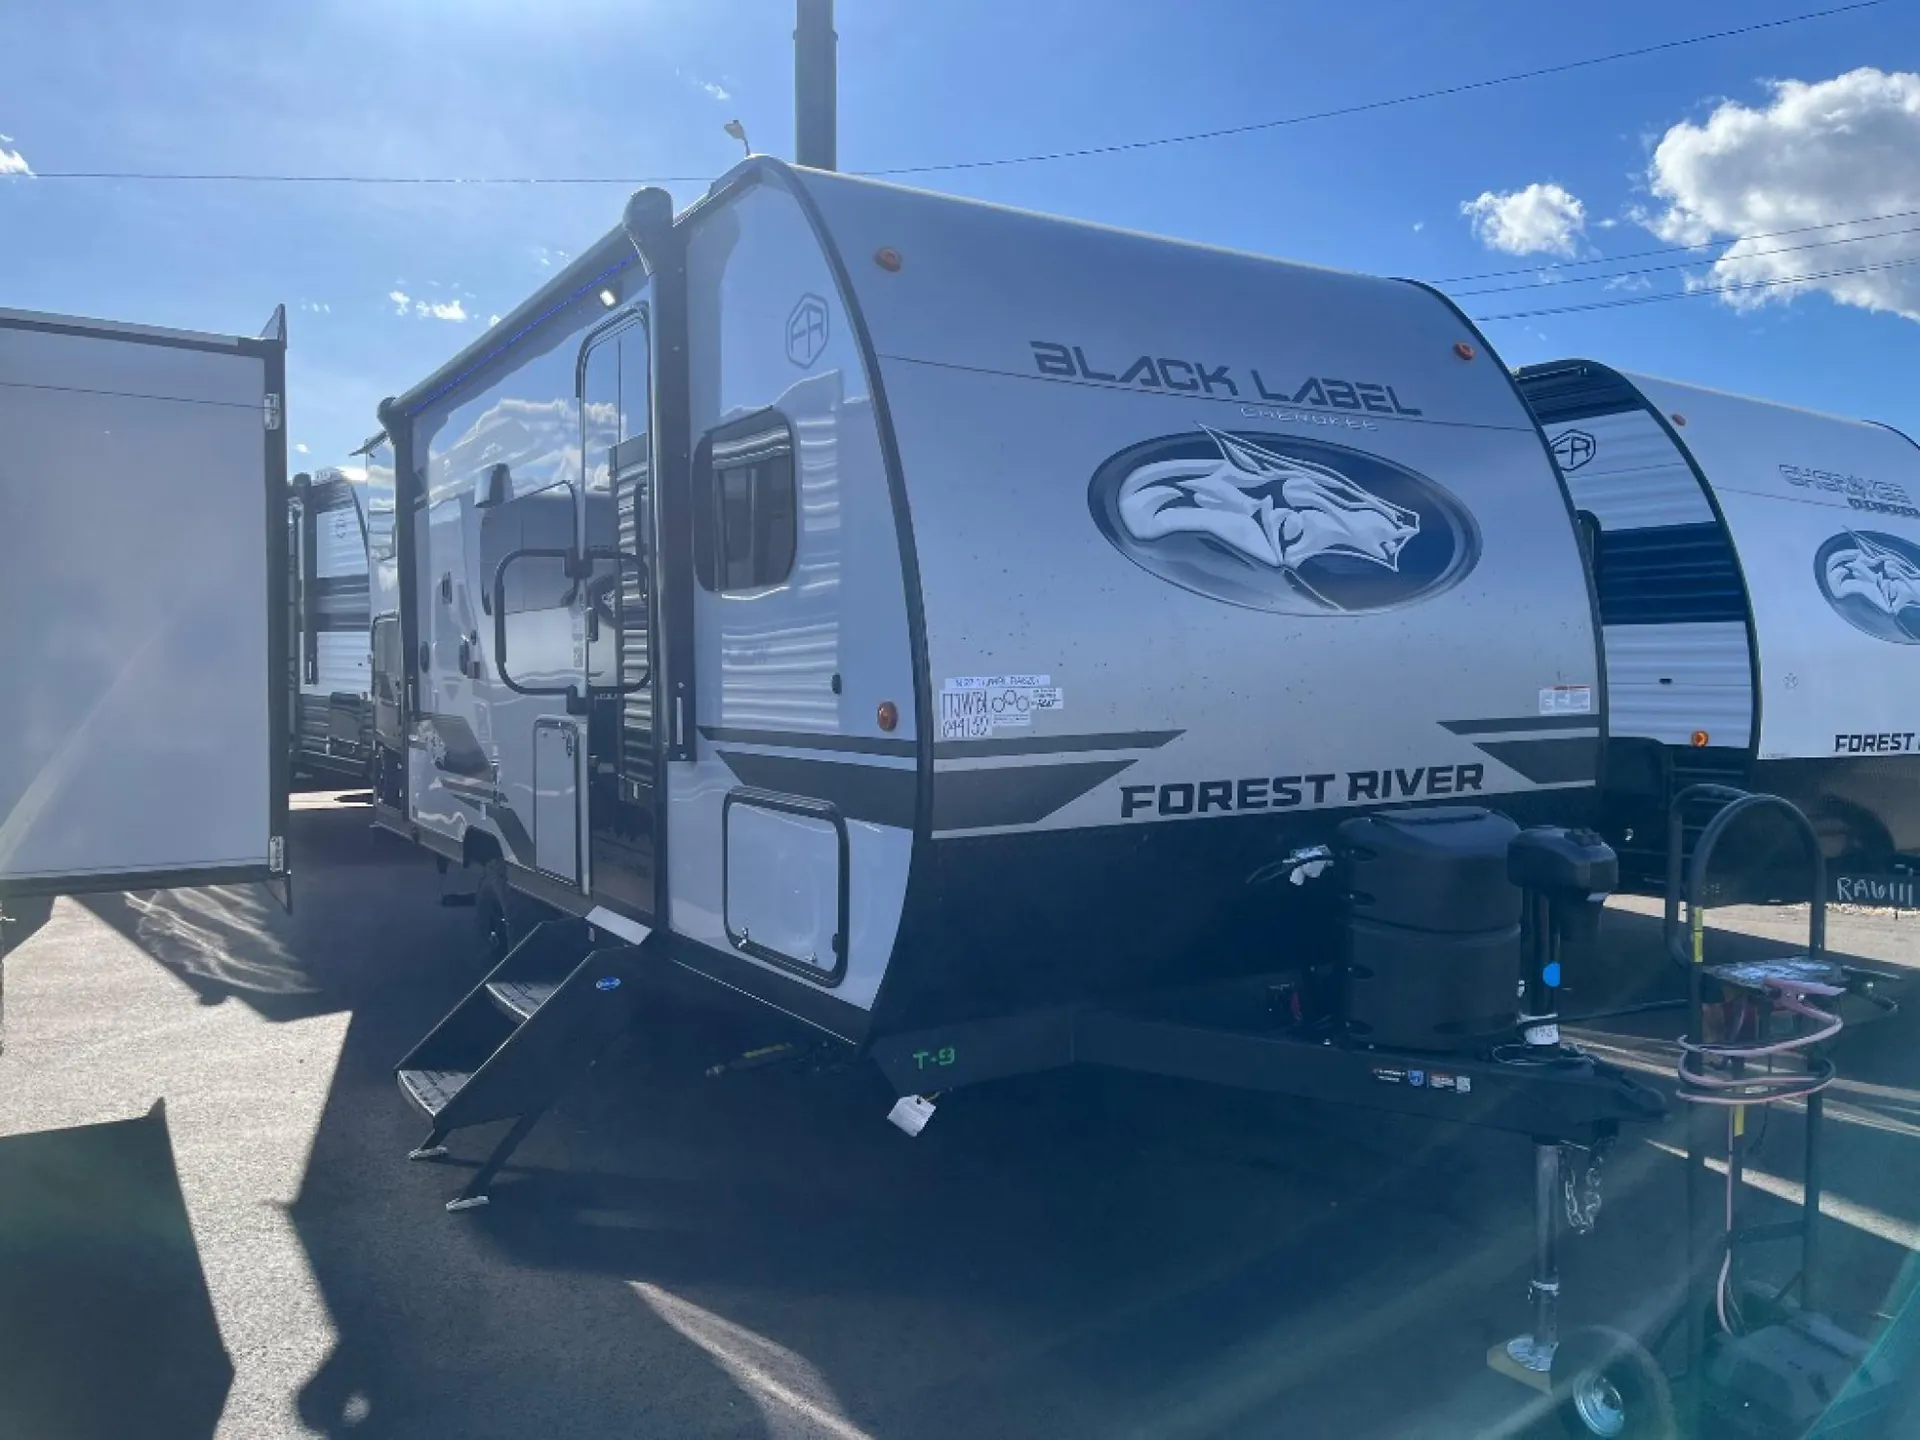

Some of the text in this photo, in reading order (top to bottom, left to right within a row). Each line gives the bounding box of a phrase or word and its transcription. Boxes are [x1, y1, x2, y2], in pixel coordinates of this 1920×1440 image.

[1029, 340, 1423, 416] BLACK LABEL
[1835, 732, 1915, 752] FOREST
[1119, 762, 1485, 818] FOREST RIVER
[912, 1047, 955, 1070] T-9
